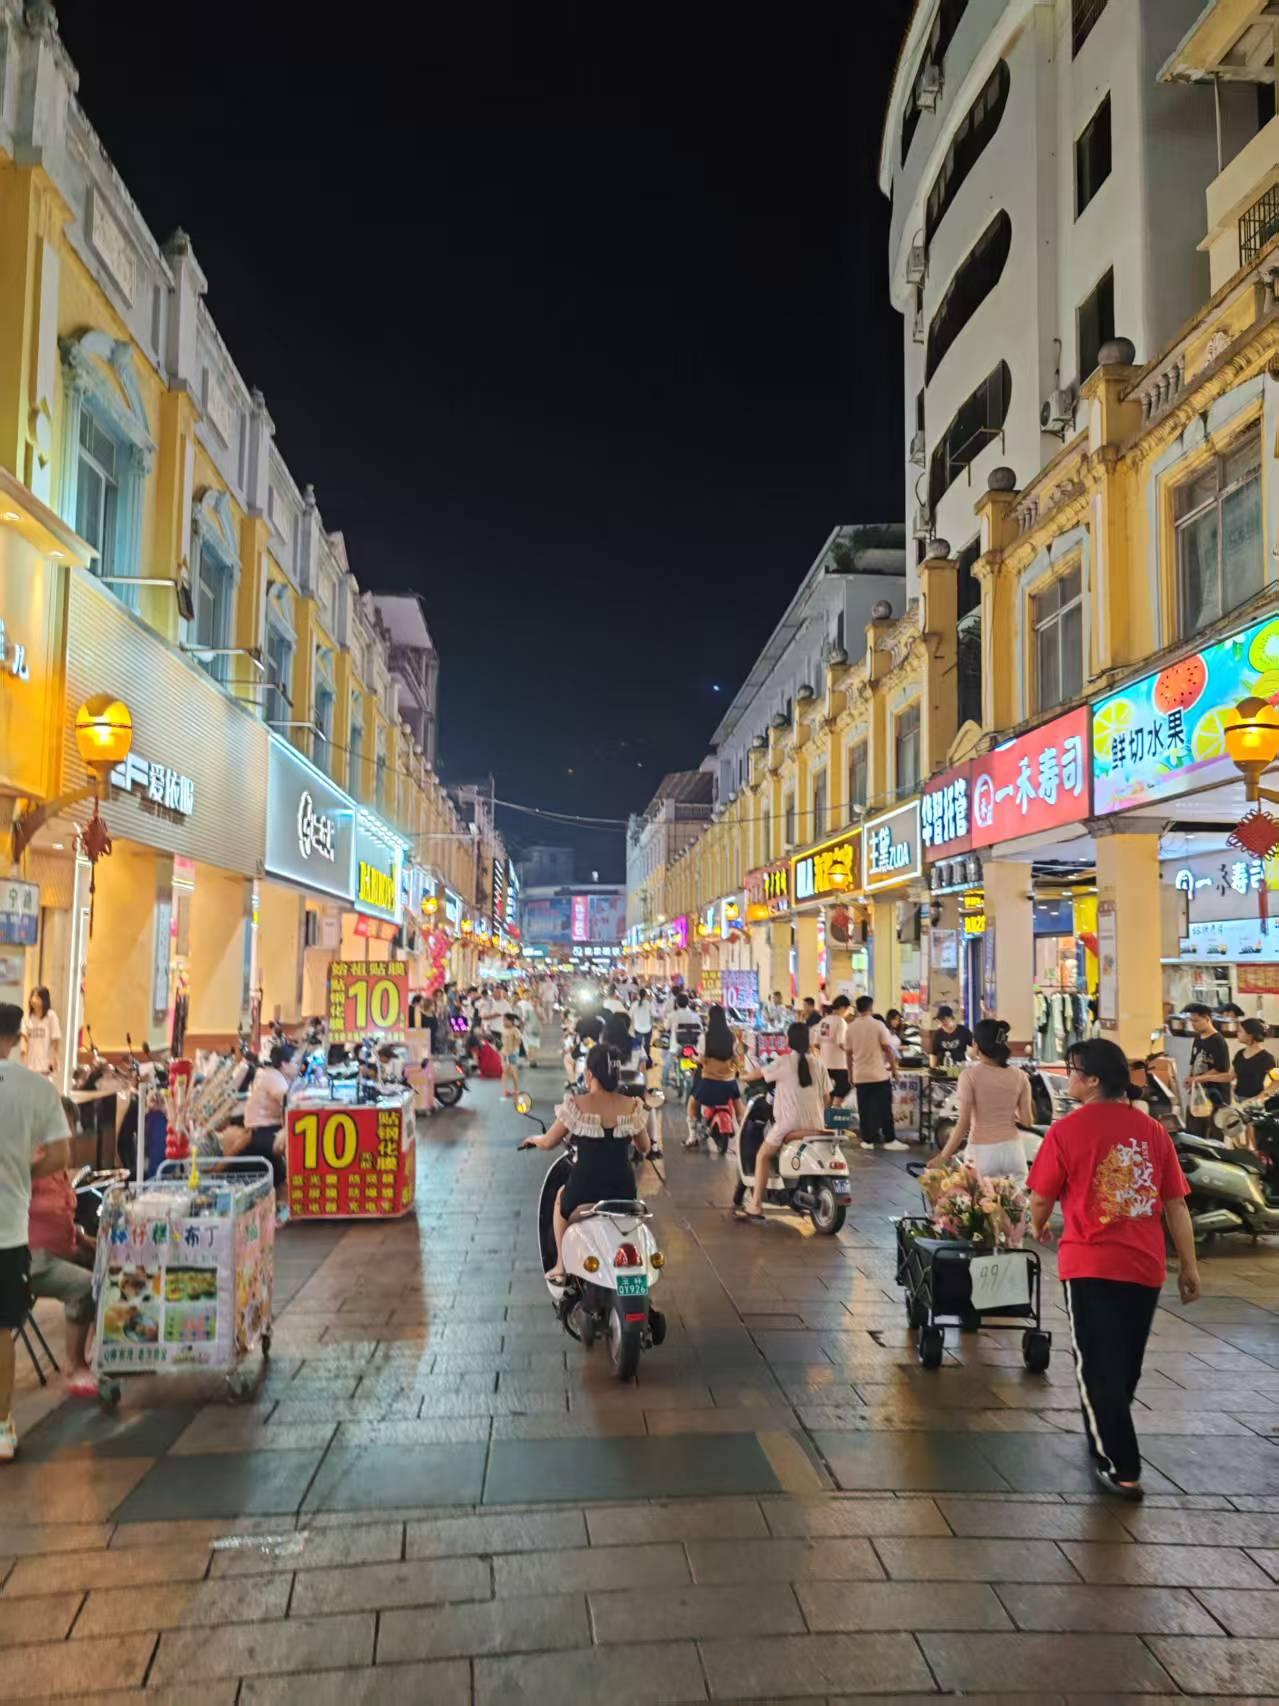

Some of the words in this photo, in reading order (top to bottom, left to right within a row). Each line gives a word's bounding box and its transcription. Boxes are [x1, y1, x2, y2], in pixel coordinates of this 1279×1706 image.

[1111, 707, 1185, 771] 鲜切水果
[921, 777, 968, 848] 华智托管
[348, 978, 400, 1029] 10
[722, 988, 737, 1007] 10
[294, 1112, 358, 1170] 10
[377, 1111, 400, 1171] 贴钢化膜
[184, 1224, 219, 1248] 布丁
